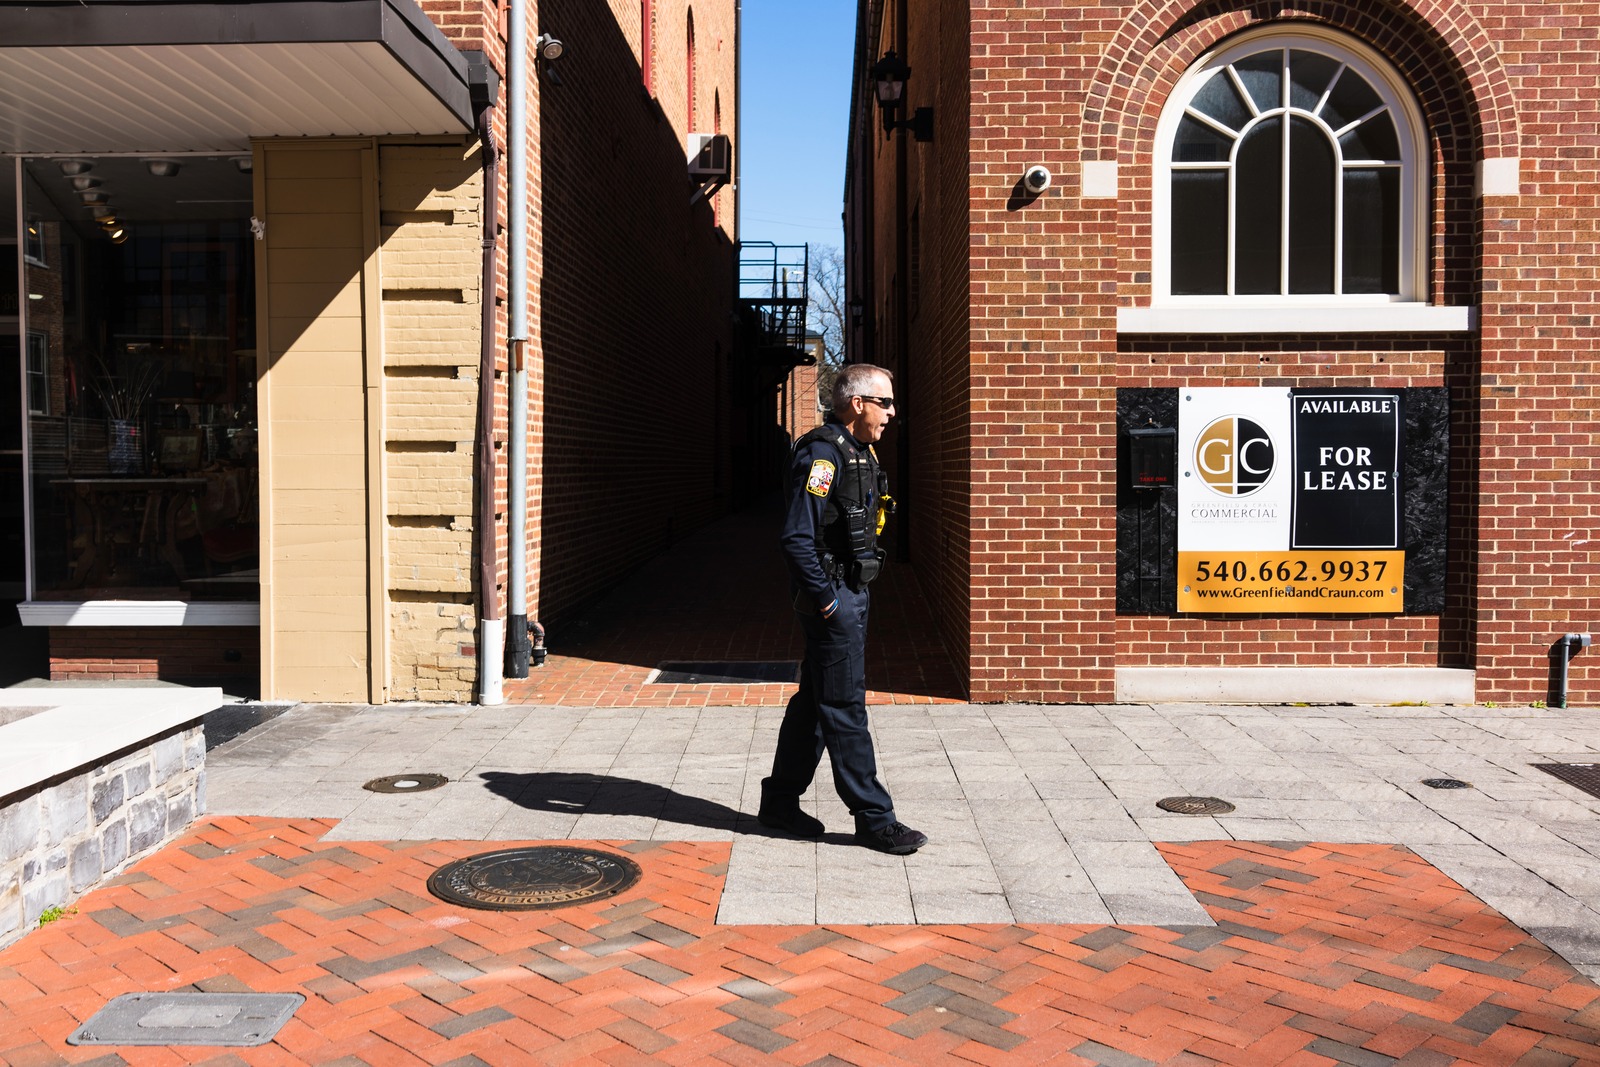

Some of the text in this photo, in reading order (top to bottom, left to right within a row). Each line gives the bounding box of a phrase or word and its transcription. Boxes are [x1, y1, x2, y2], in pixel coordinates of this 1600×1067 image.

[1300, 400, 1391, 413] AVAILABLE
[1199, 438, 1270, 475] G C
[1319, 446, 1372, 466] FOR
[1303, 471, 1387, 490] LEASE
[1191, 508, 1278, 518] COMMERCIAL
[1196, 560, 1388, 582] 540.662.9937
[513, 896, 542, 904] OF
[551, 888, 595, 902] CITY
